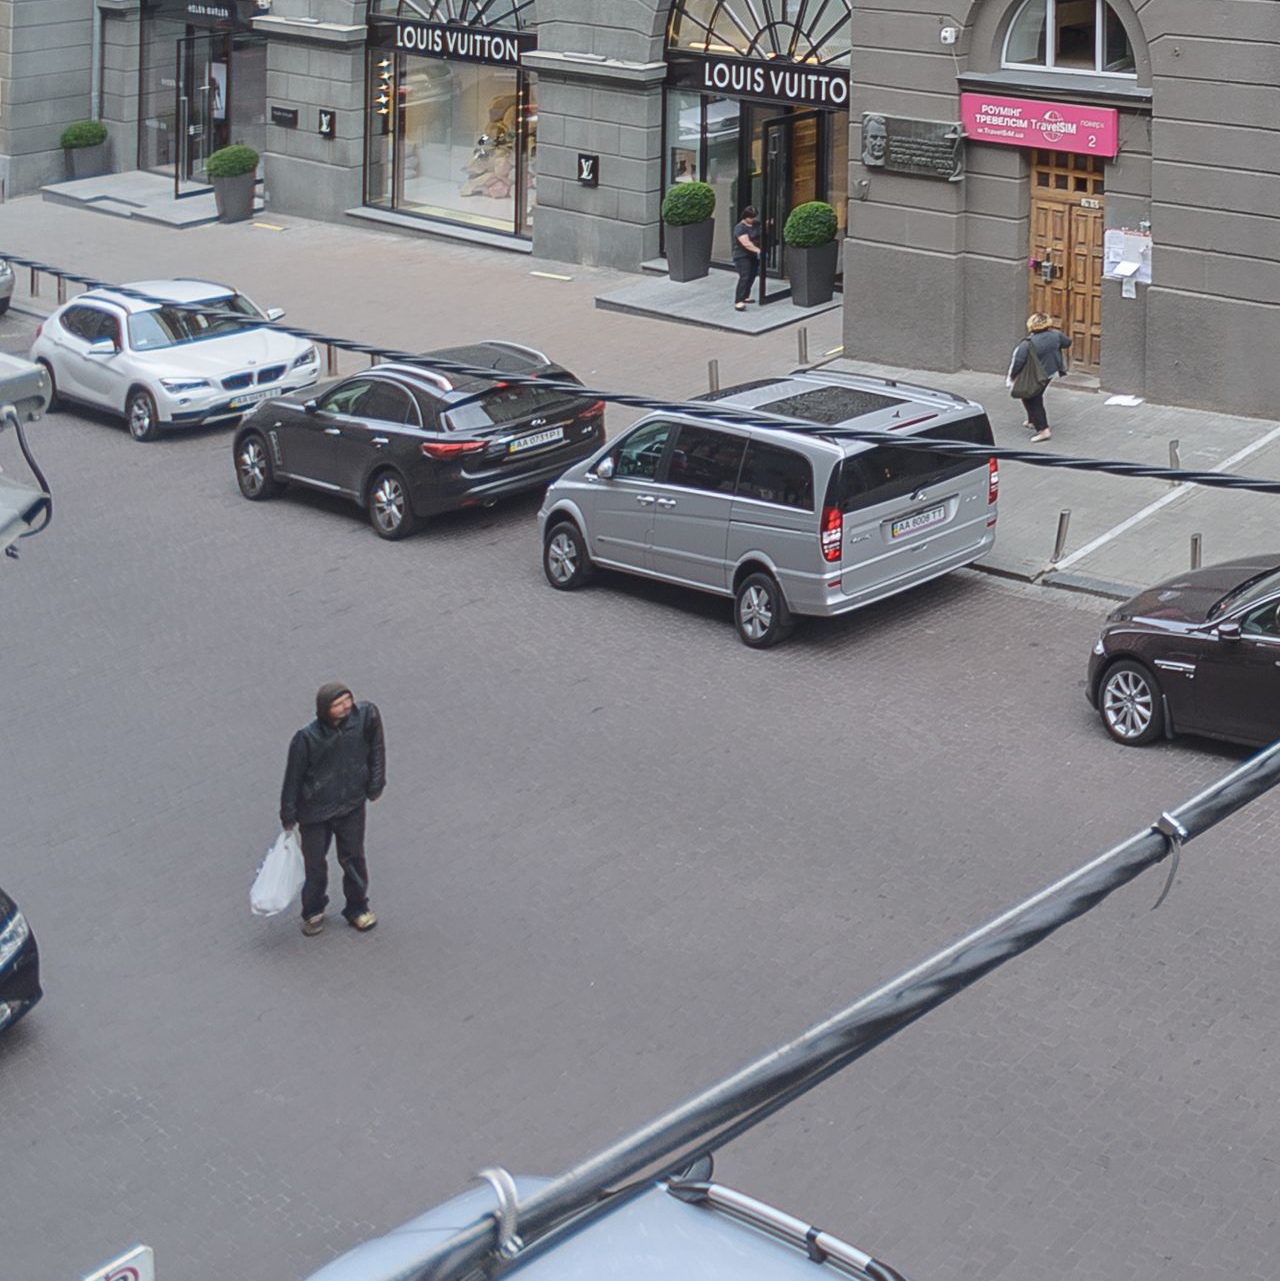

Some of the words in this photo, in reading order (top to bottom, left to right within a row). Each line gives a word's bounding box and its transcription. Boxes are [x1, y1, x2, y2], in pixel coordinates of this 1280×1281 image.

[396, 25, 442, 52] LOUIS
[446, 31, 518, 62] VUITTON
[704, 62, 764, 93] LOUIS
[770, 70, 847, 103] VUITTO
[981, 104, 1022, 117] РОУМІНГ
[975, 114, 1028, 128] ТРЕВЕЛСІМ
[1088, 134, 1097, 147] 2
